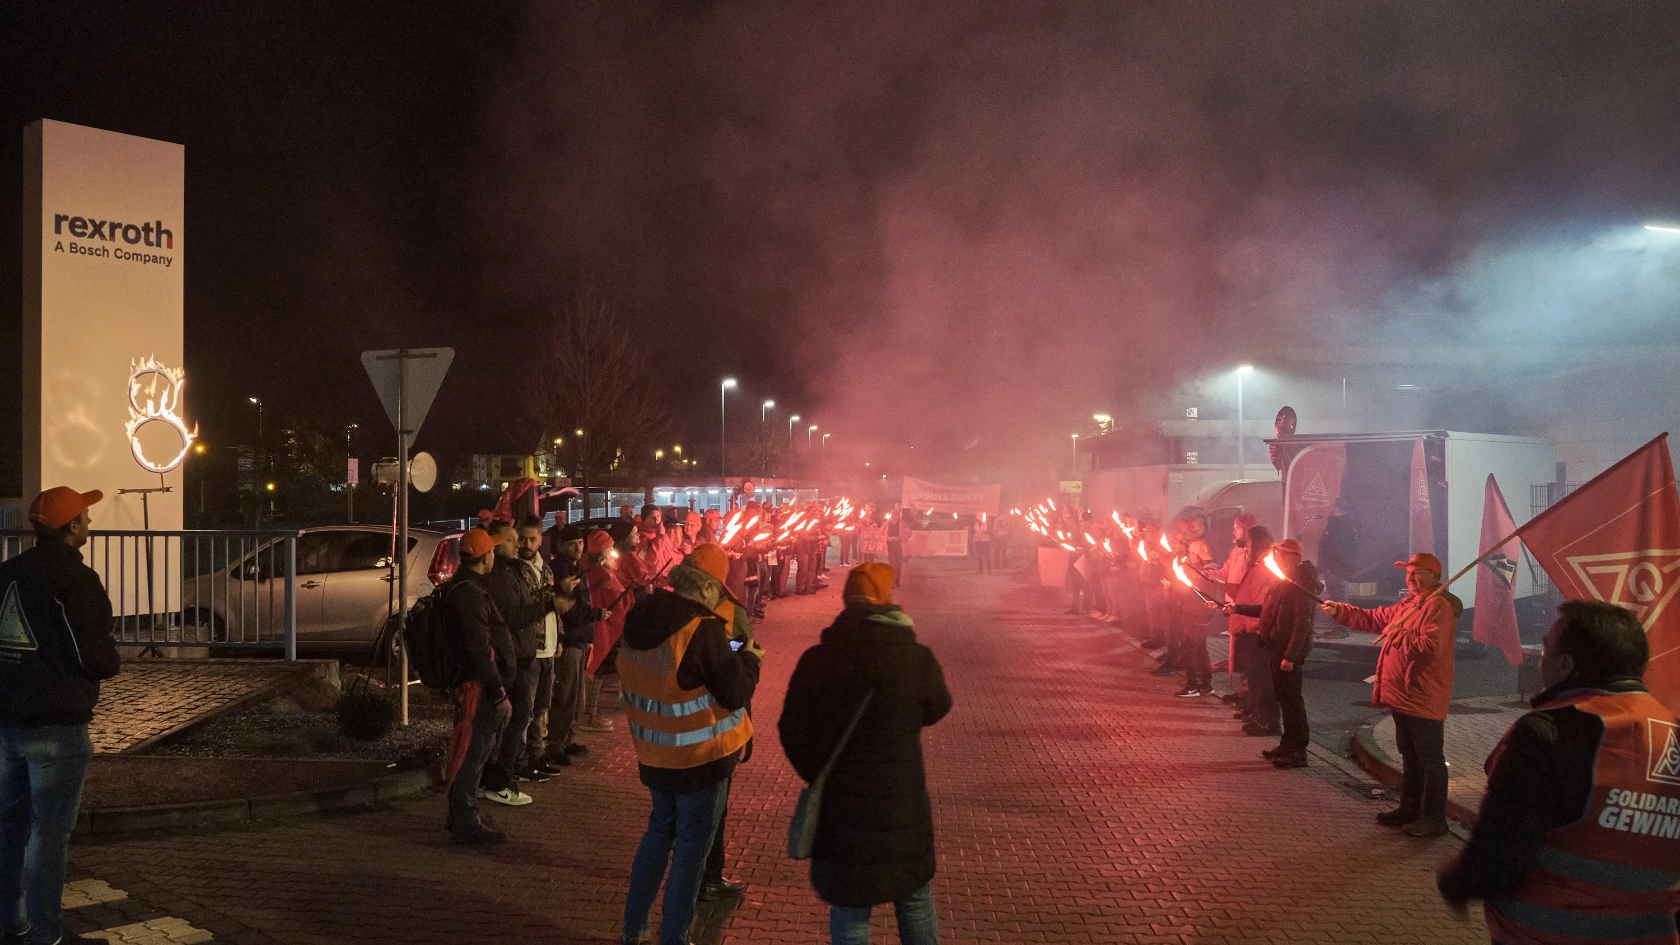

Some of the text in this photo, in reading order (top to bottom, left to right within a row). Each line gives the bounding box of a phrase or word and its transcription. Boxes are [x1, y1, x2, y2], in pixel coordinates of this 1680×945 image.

[54, 213, 173, 249] rexroth
[54, 241, 173, 267] A Bosch Company
[1605, 788, 1680, 815] SOLIDAR
